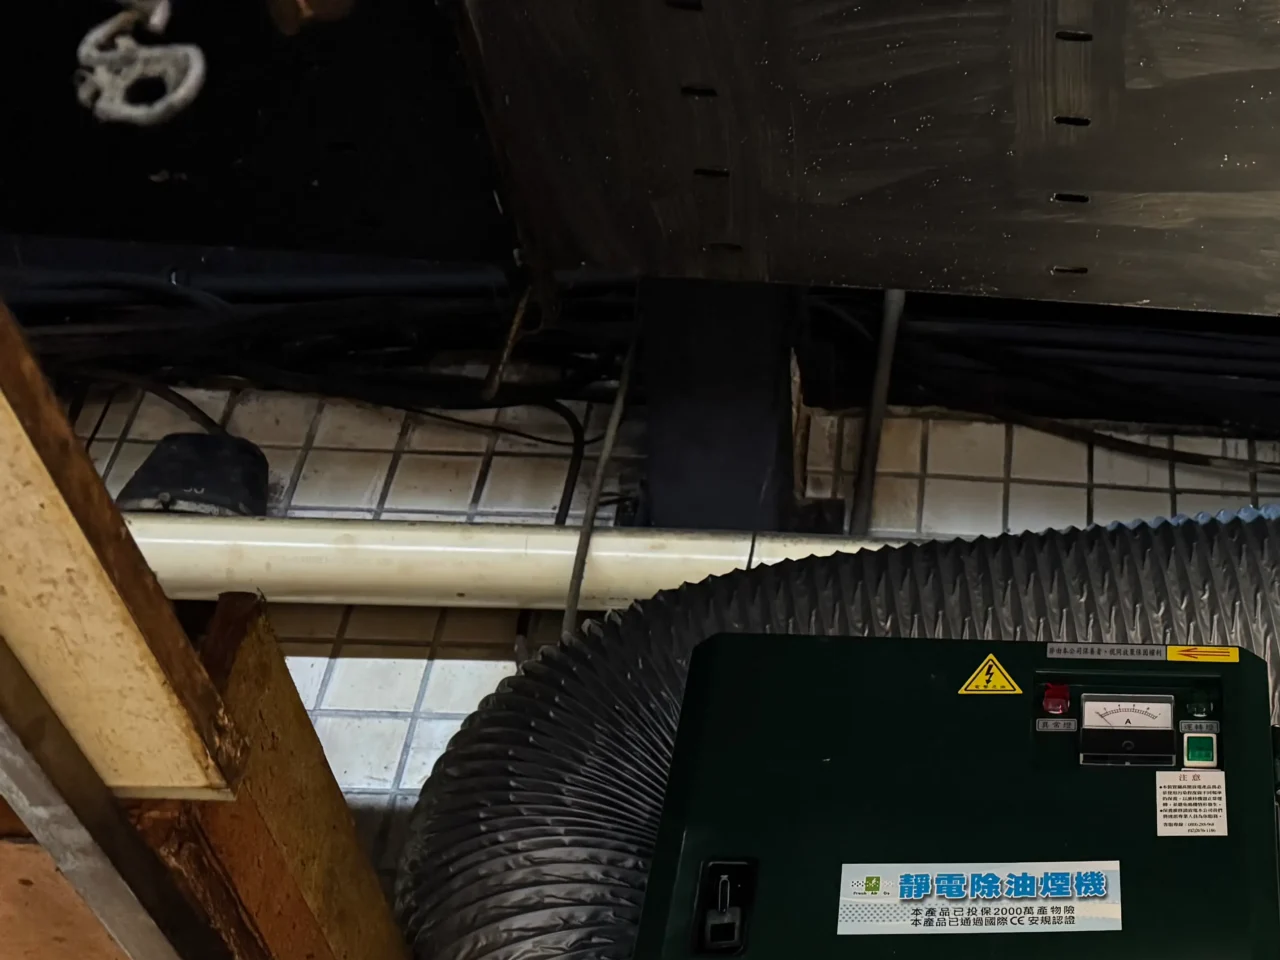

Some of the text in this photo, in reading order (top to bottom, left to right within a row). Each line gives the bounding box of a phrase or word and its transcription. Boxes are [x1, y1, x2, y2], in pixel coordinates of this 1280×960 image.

[1179, 773, 1201, 781] 注意
[899, 871, 1106, 899] 靜電除油煙機
[911, 905, 1075, 917] 本產品已投保2000萬產物險
